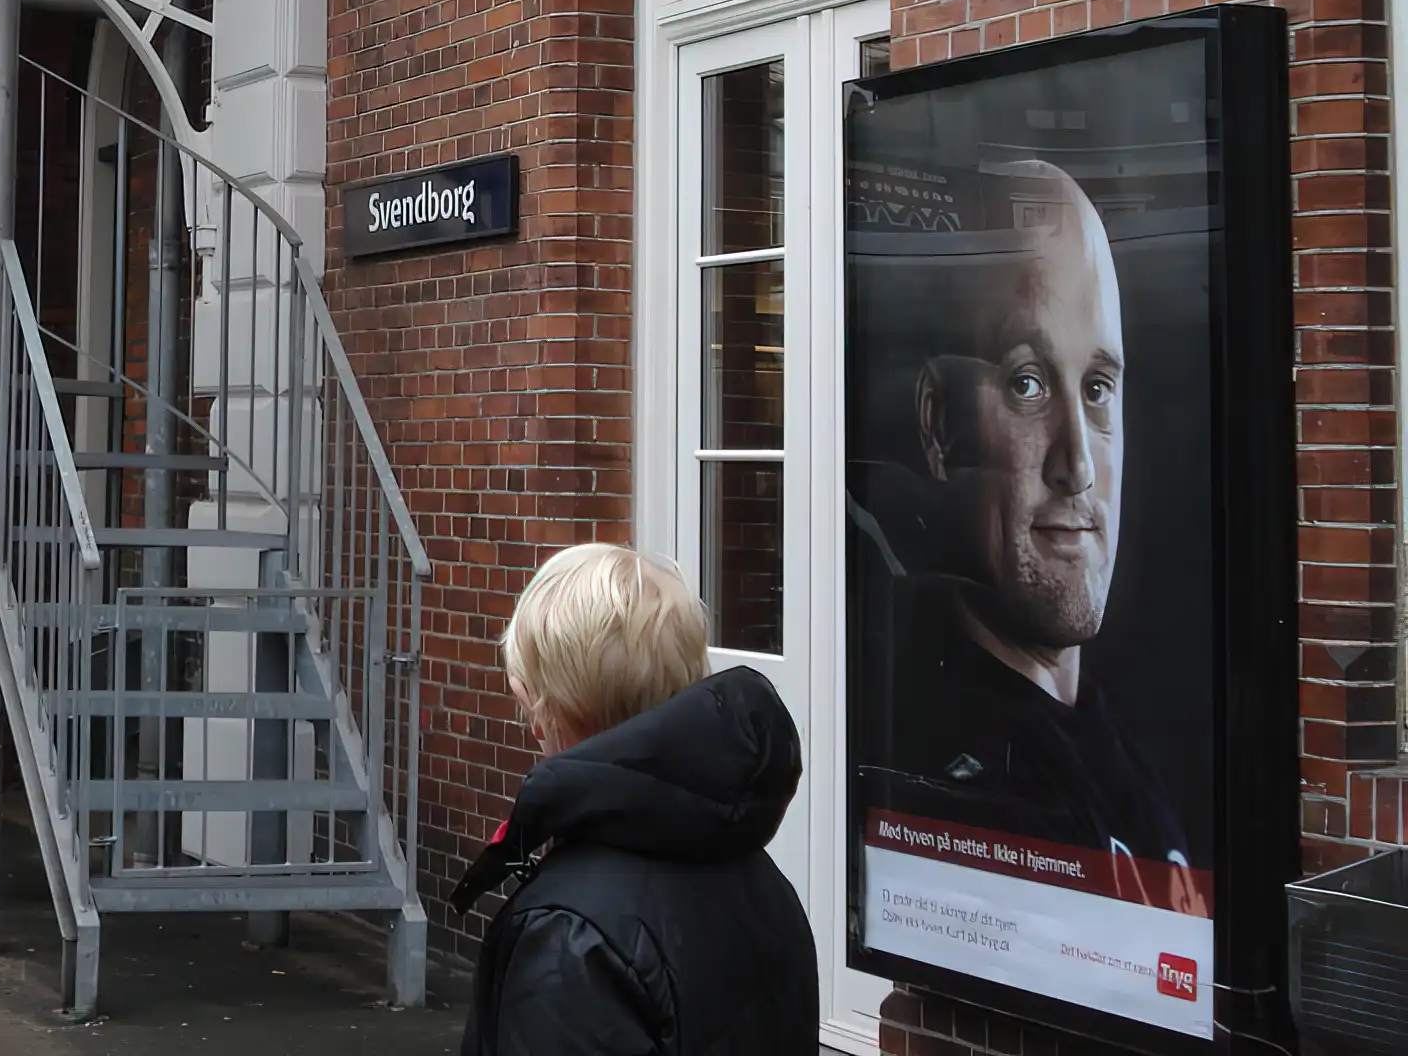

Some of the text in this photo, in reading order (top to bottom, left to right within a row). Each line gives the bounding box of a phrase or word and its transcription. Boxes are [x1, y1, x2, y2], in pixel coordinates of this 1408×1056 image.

[368, 180, 475, 233] Svendborg
[903, 826, 935, 846] tyven
[937, 832, 951, 852] på
[953, 838, 991, 859] nettet.
[994, 844, 1017, 865] Ikke
[1027, 849, 1086, 878] hjemmet.
[1160, 963, 1193, 993] Tryg
